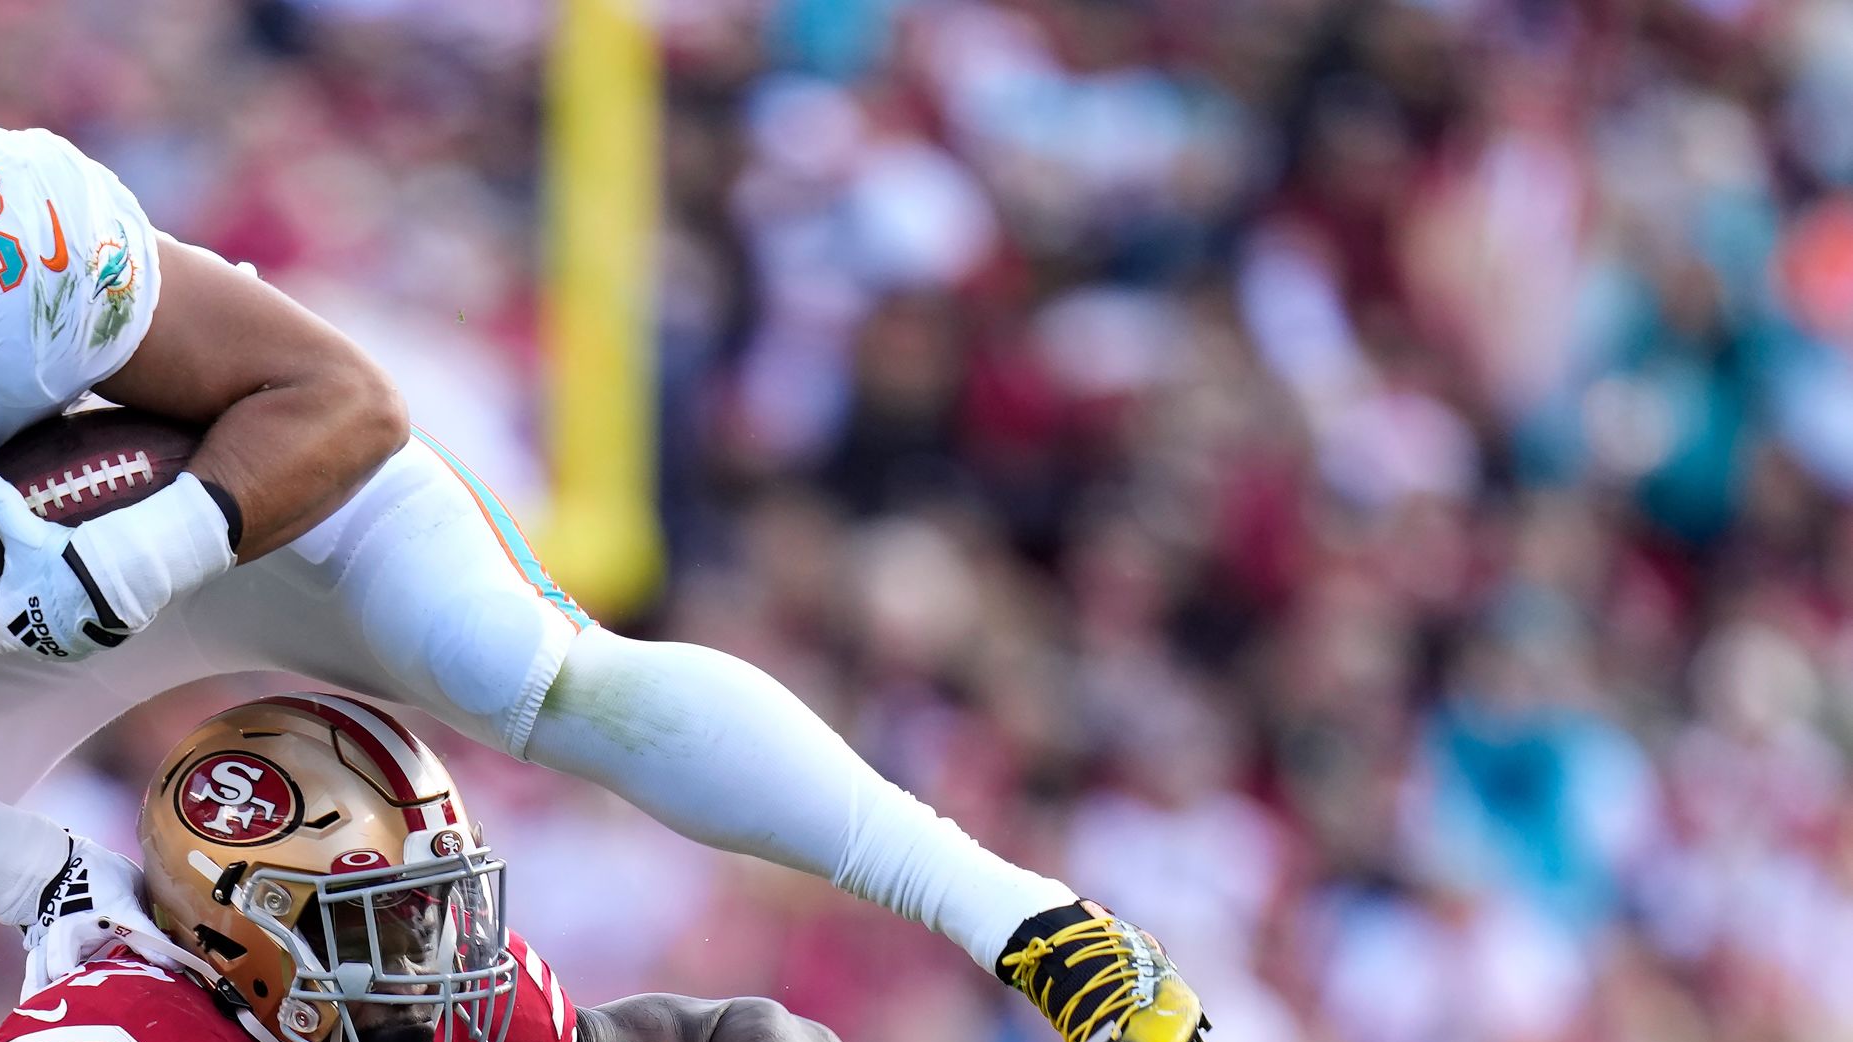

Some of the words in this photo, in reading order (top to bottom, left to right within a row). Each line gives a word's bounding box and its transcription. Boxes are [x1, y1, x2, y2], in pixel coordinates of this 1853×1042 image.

[28, 596, 69, 657] adidas
[189, 760, 276, 835] SF
[114, 925, 133, 938] 57
